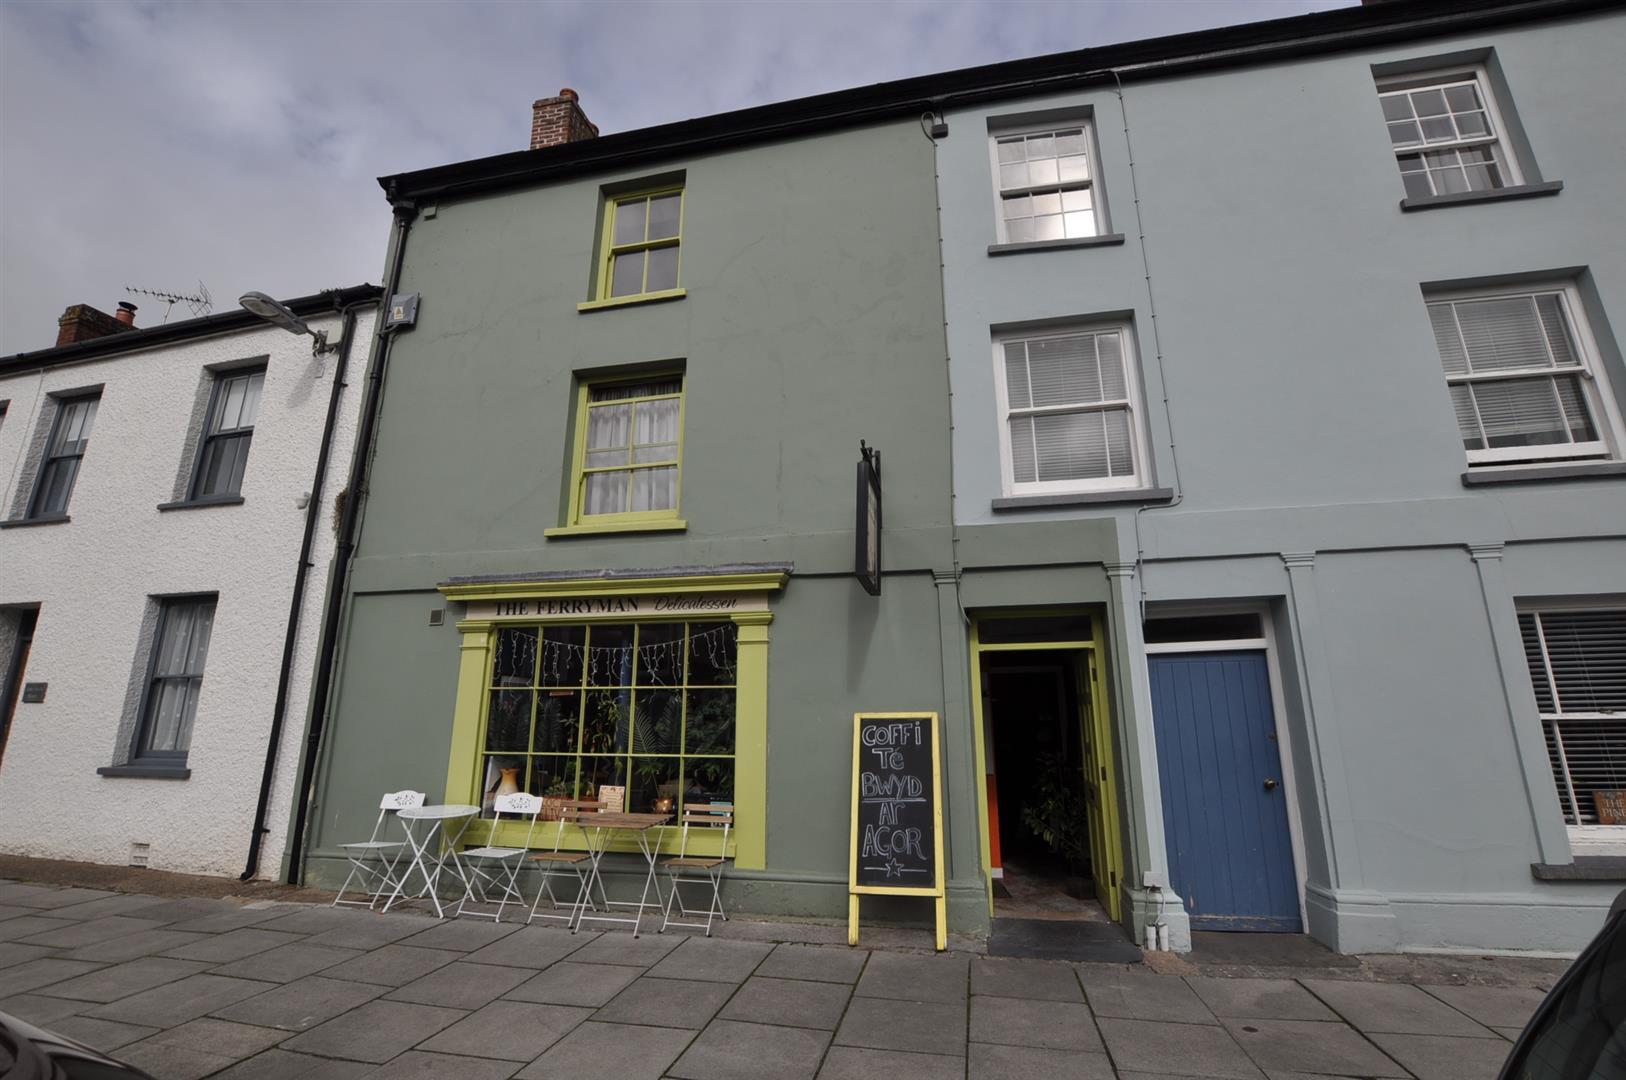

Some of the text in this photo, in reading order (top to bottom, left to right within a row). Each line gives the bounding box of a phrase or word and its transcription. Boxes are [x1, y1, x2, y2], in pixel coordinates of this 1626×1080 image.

[496, 595, 738, 616] THE FERRYMAN Delicatessen
[861, 824, 927, 860] AGOR
